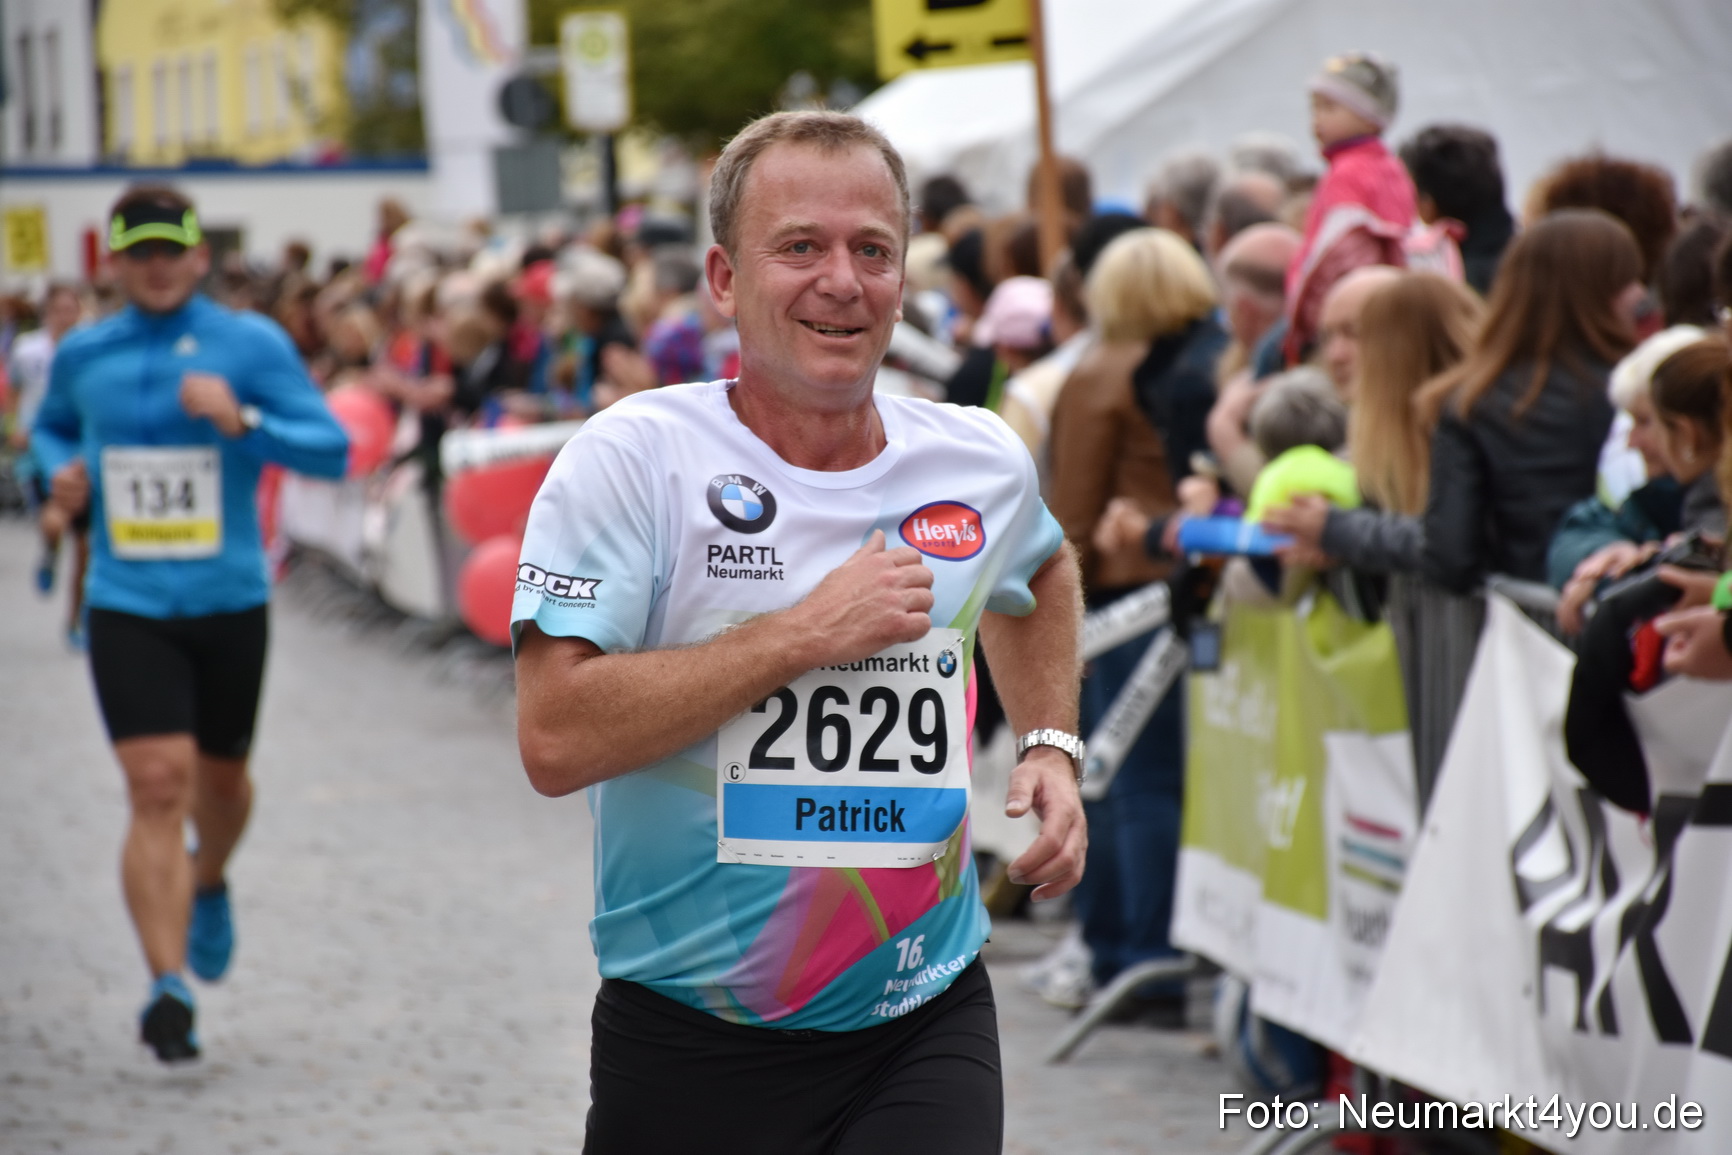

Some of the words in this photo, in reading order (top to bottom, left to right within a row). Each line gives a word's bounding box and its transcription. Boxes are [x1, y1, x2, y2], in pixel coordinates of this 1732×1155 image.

[130, 478, 195, 516] 134
[711, 476, 767, 496] BMW
[912, 518, 977, 545] Hervis
[707, 544, 784, 566] PARTL
[517, 563, 603, 600] OCK
[707, 564, 785, 581] Neumarkt
[523, 584, 534, 593] by
[558, 601, 596, 609] concepts
[748, 684, 948, 775] 2629
[730, 764, 740, 780] C
[795, 797, 906, 833] Patrick
